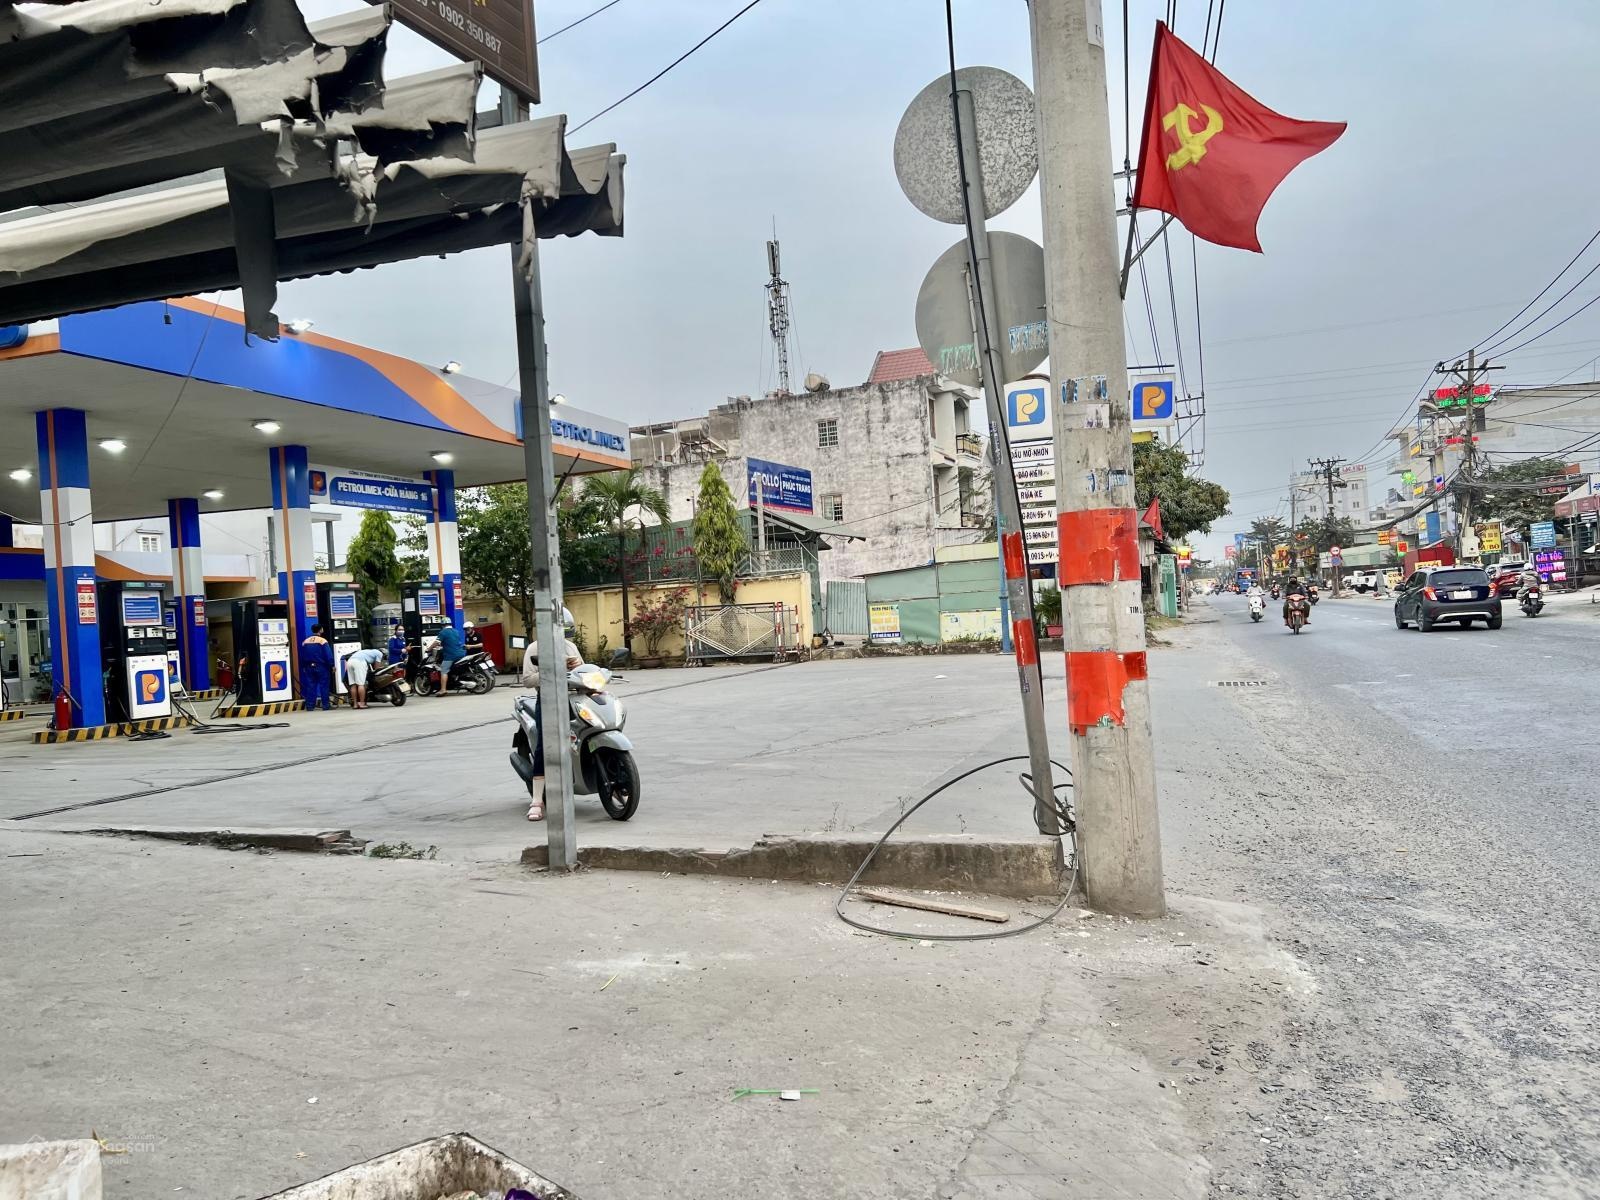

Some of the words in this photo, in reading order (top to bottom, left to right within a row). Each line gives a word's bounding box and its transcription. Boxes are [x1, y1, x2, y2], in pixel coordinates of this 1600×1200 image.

[439, 1, 464, 31] 0902
[466, 19, 484, 43] 350
[485, 31, 501, 54] 887
[550, 420, 625, 451] ETROLIMEX
